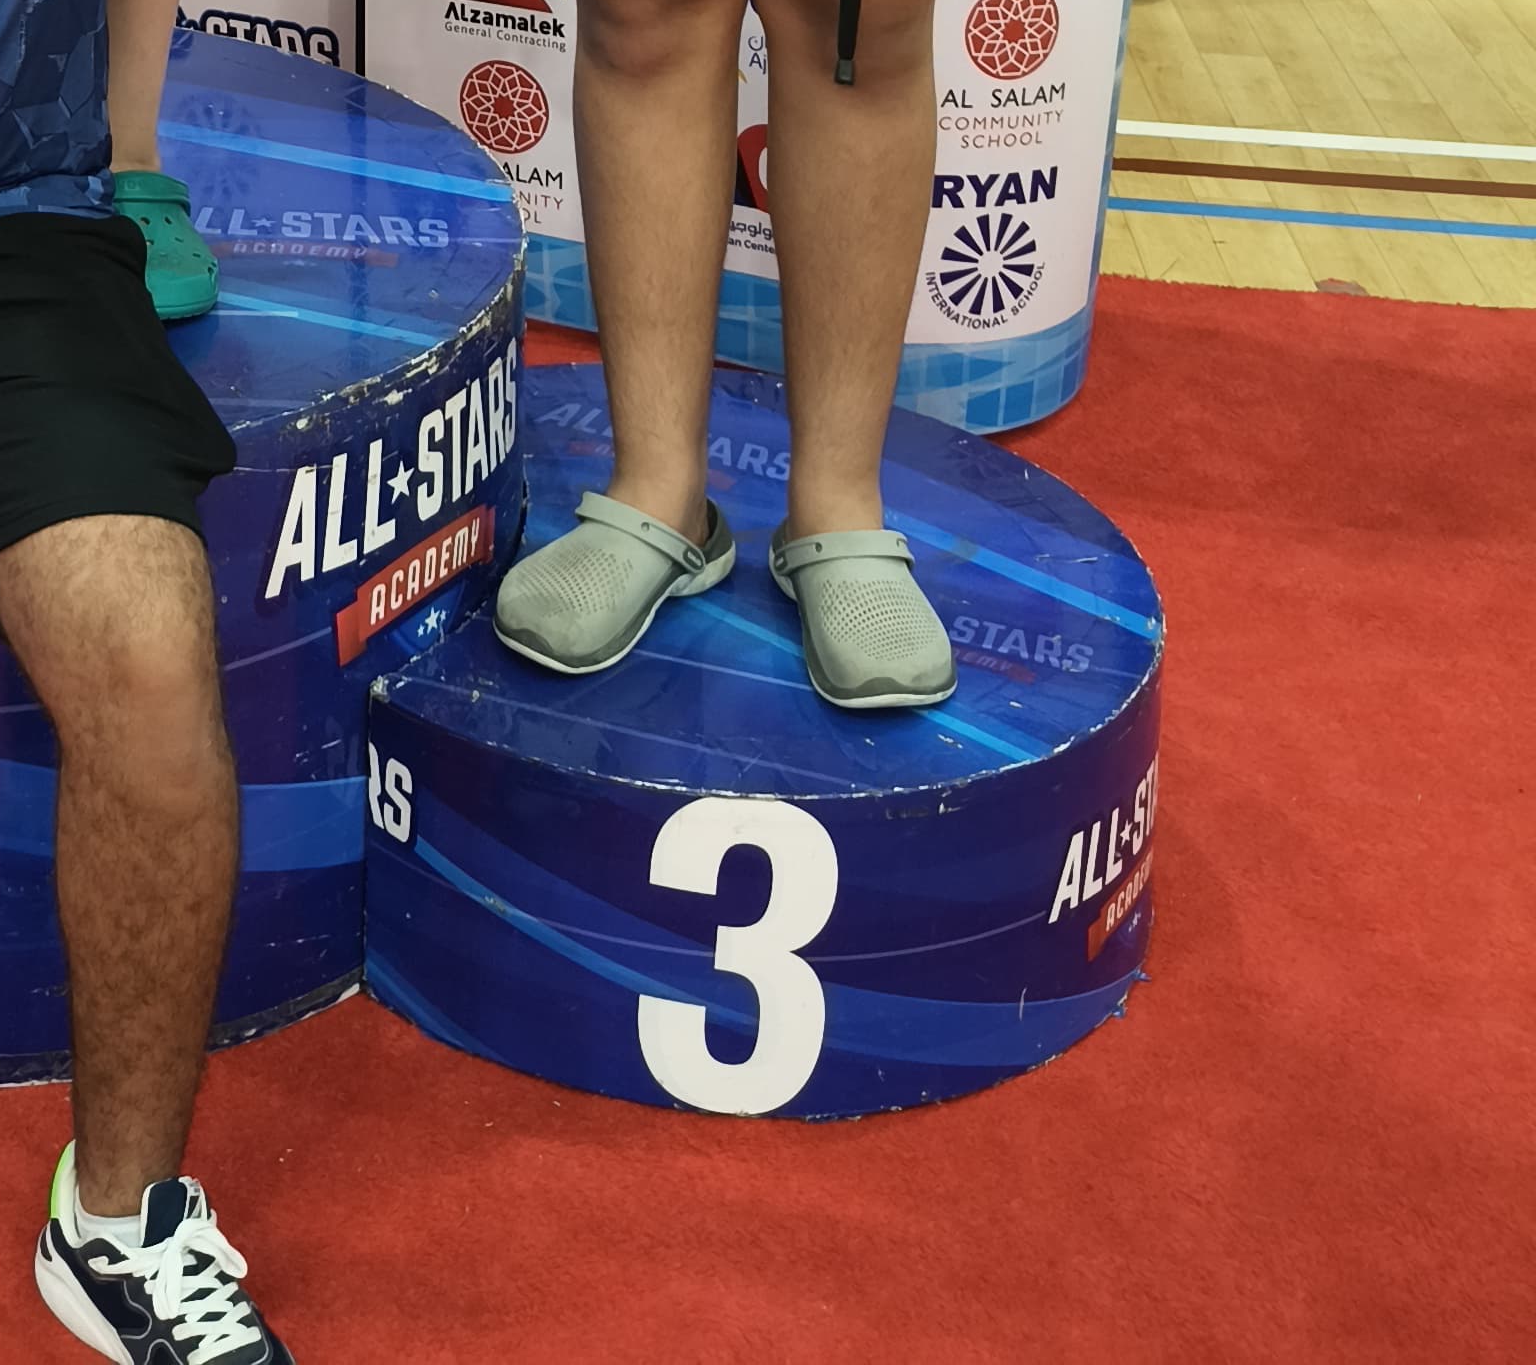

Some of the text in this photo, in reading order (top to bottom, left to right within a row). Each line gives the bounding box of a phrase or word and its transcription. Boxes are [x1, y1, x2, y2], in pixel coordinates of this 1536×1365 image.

[444, 1, 566, 38] Alzamalek
[444, 21, 567, 53] General Contracting
[941, 82, 1066, 109] AL SALAM
[938, 109, 1065, 131] COMMUNITY
[960, 131, 1043, 149] SCHOOL
[932, 166, 1058, 209] RYAN
[194, 207, 450, 248] LL STARS
[925, 261, 1046, 330] INTERNATIONAL SCHOOL
[266, 337, 518, 599] ALL STARS
[368, 520, 482, 627] ACADEMY
[949, 616, 1094, 673] STARS
[1048, 807, 1123, 924] ALL
[638, 797, 839, 1116] 3
